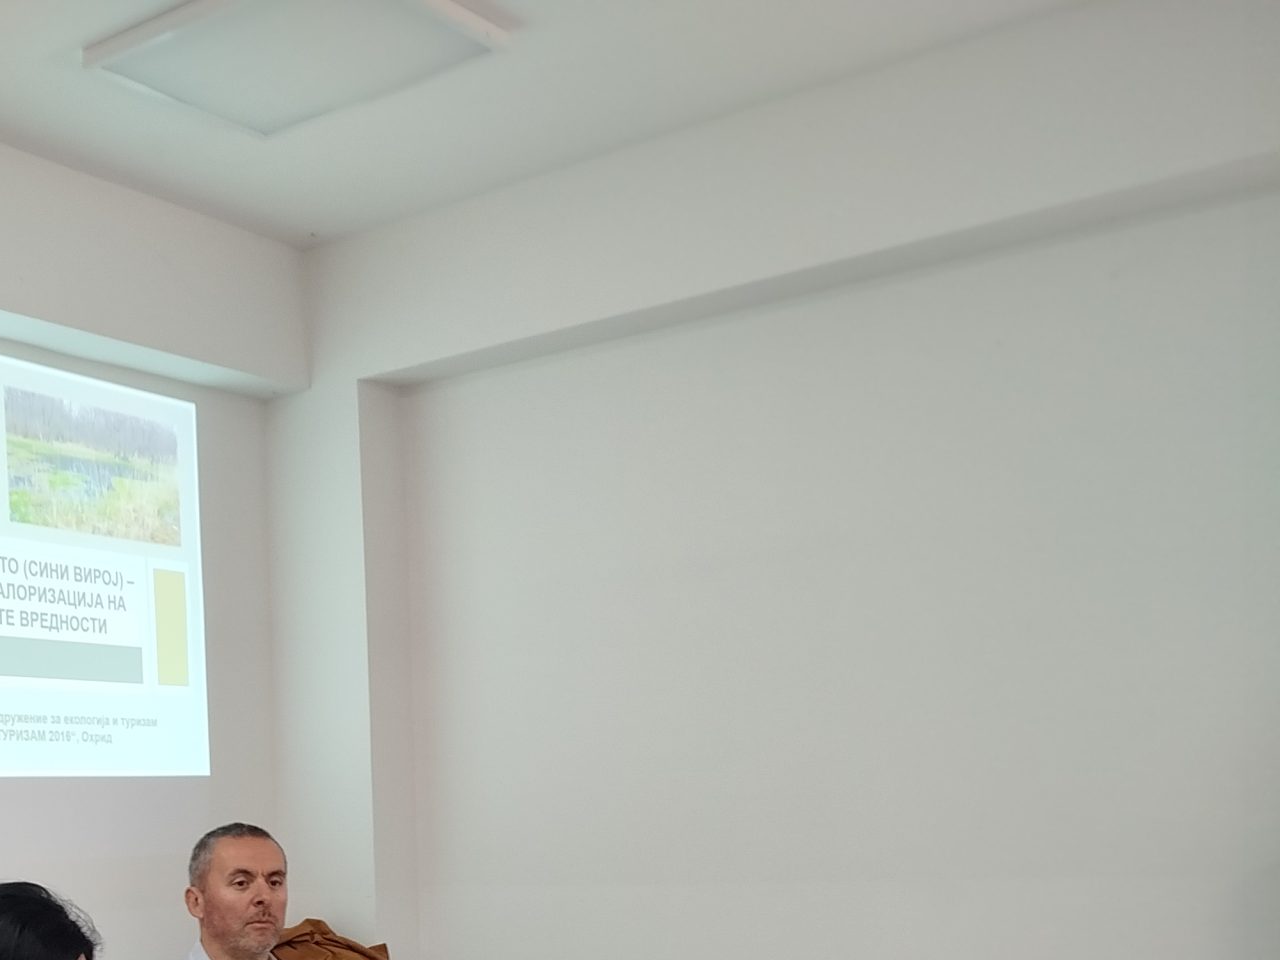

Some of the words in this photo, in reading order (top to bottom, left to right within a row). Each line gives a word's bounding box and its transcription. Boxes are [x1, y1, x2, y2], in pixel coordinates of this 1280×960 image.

[23, 560, 69, 582] (СИНИ
[73, 566, 123, 591] ВИРОЈ)
[107, 594, 127, 612] НА
[19, 610, 108, 634] ВРЕДНОСТИ
[50, 714, 61, 724] за
[112, 716, 119, 726] и
[120, 716, 158, 729] туризам
[81, 730, 113, 745] Охрид
